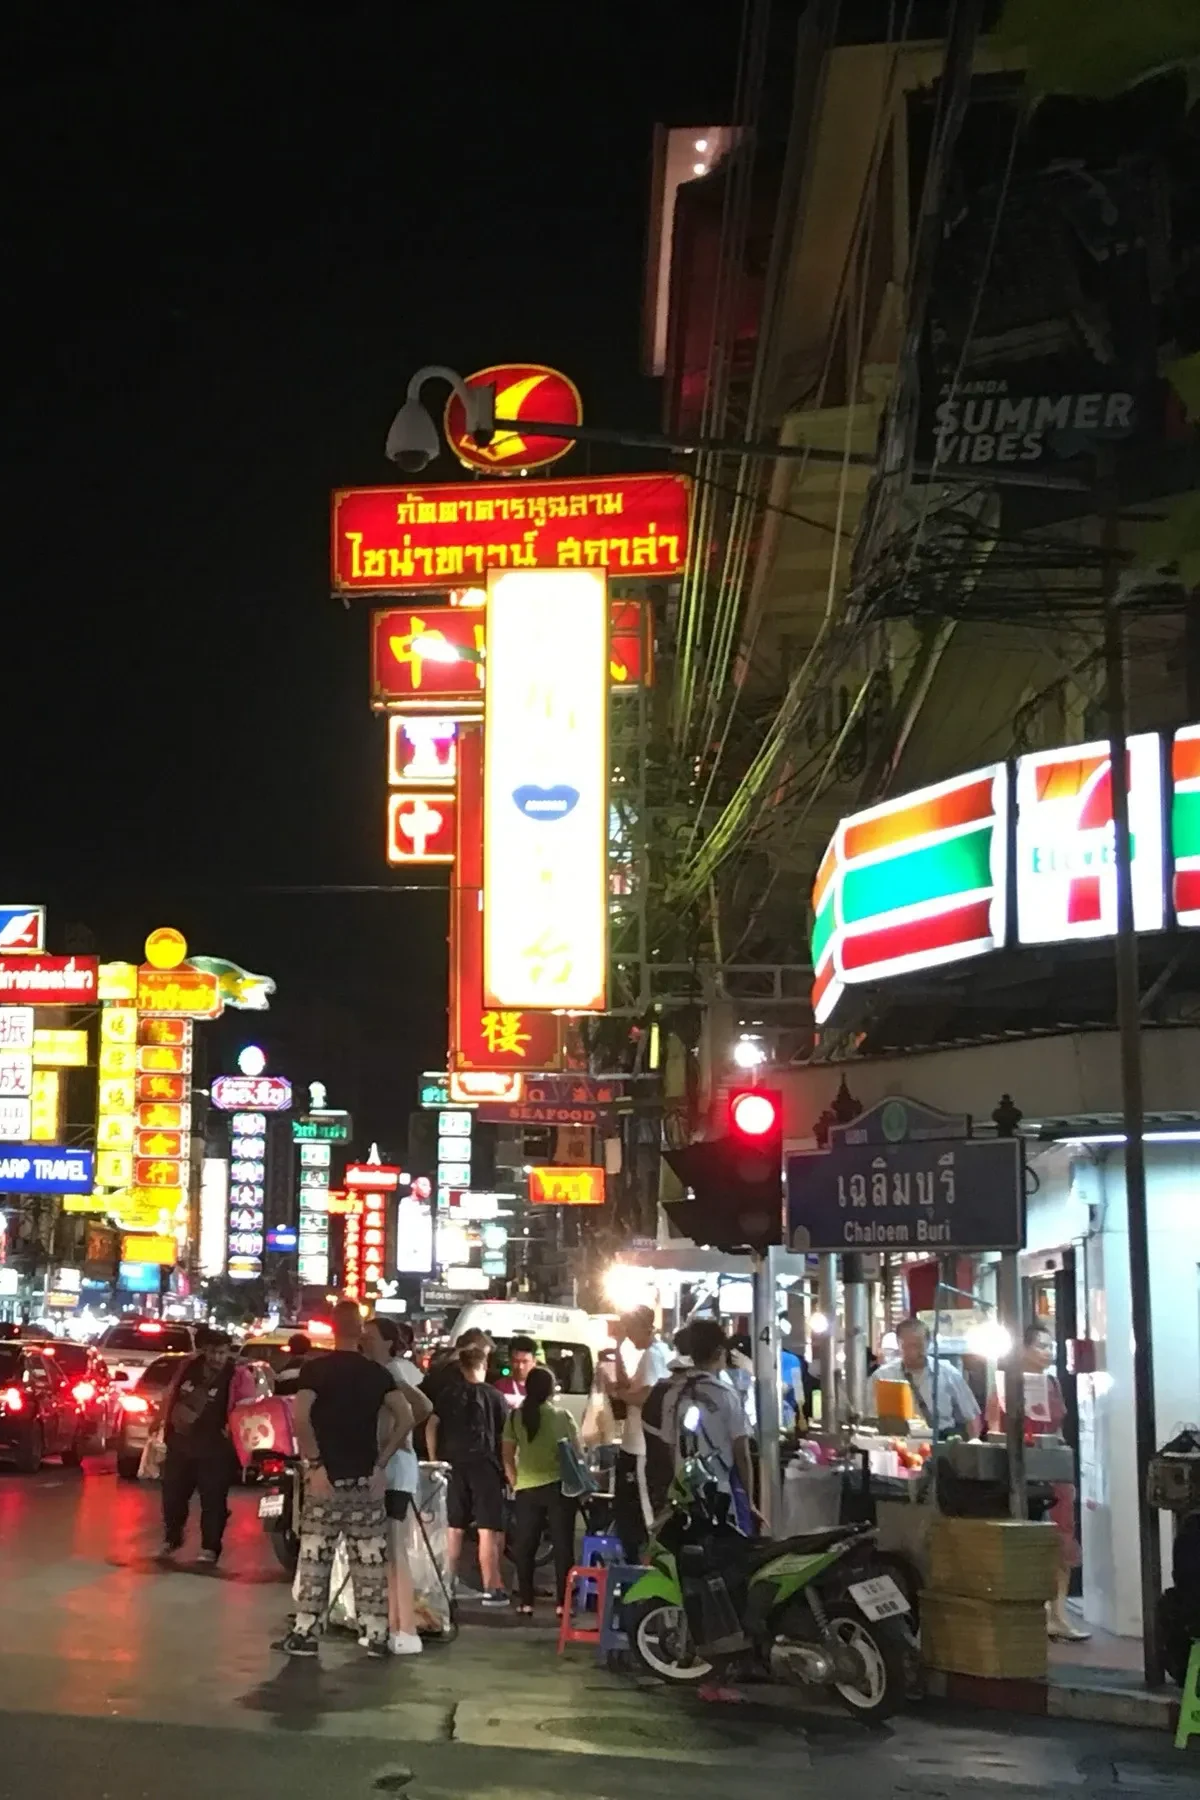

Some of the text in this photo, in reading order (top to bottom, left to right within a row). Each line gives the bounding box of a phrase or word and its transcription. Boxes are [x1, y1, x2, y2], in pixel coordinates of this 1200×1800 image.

[933, 393, 1133, 435] SUMMER
[935, 432, 1042, 463] VIBES
[557, 523, 680, 567] สกาล่า
[509, 1107, 597, 1122] SEAFOOD
[32, 1158, 89, 1182] TRAVEL
[837, 1151, 956, 1217] เฉลิมบุรี
[843, 1218, 951, 1243] Chaloem Buri
